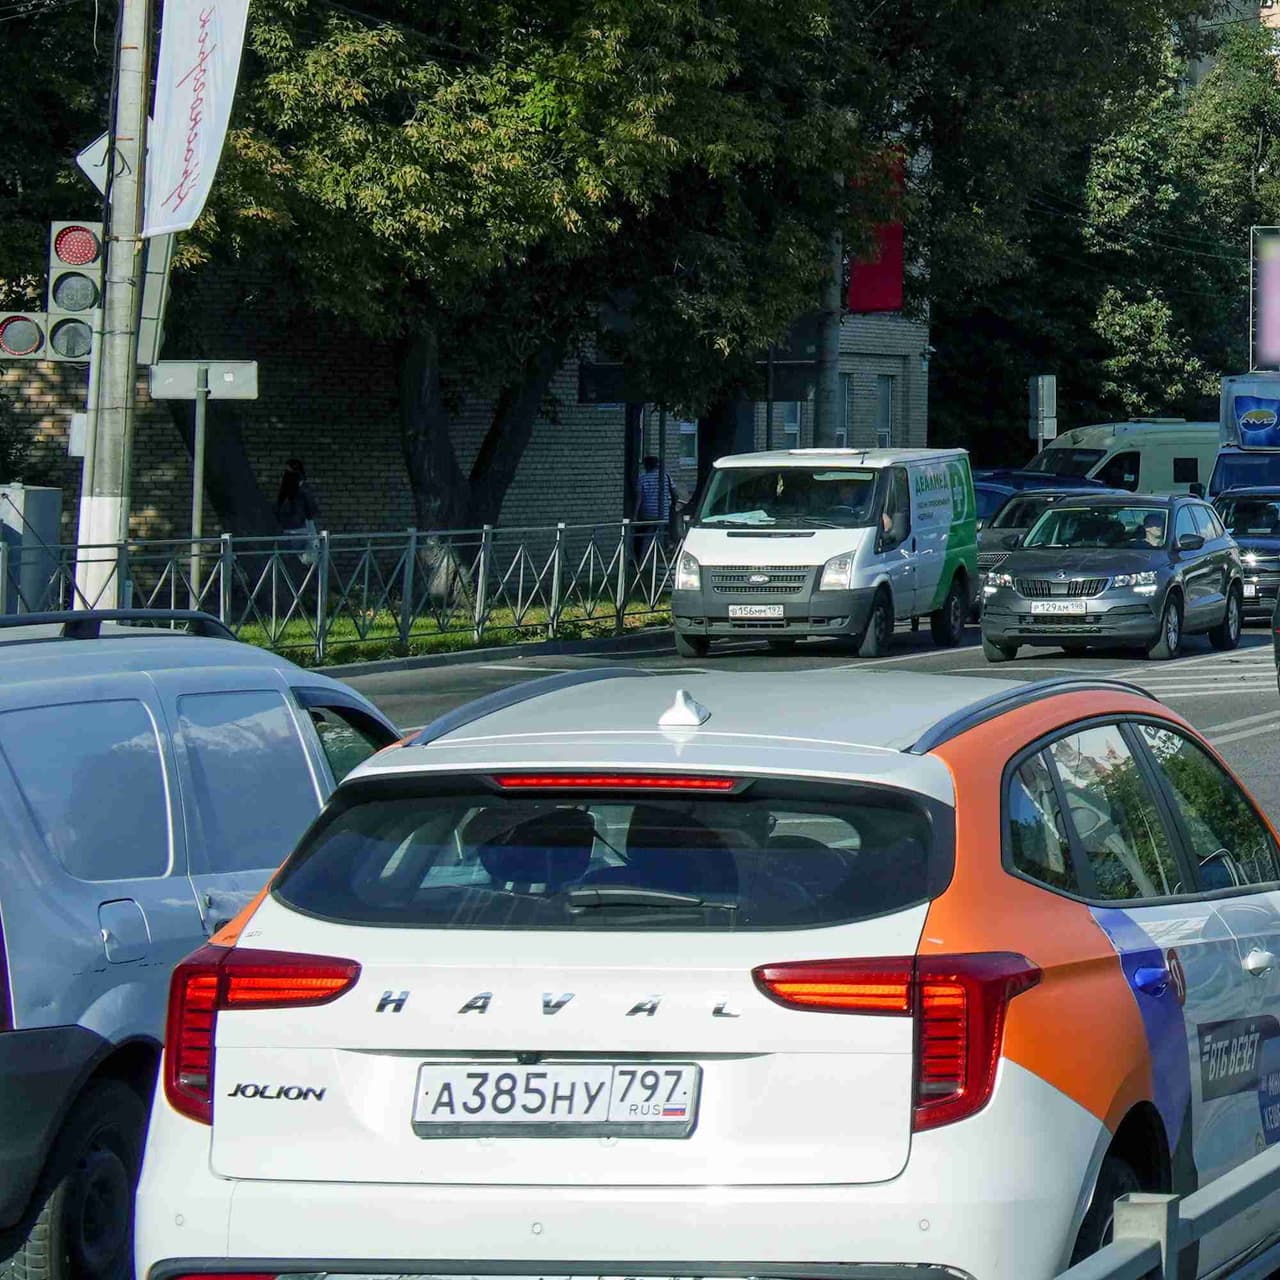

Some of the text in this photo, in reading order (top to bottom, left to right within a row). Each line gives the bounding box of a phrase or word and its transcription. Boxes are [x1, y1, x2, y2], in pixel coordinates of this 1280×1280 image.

[375, 990, 741, 1018] HAVAL
[1208, 1039, 1230, 1081] ВТБ
[227, 1082, 327, 1102] JOLION
[618, 1070, 684, 1103] 797
[629, 1103, 661, 1116] RUS
